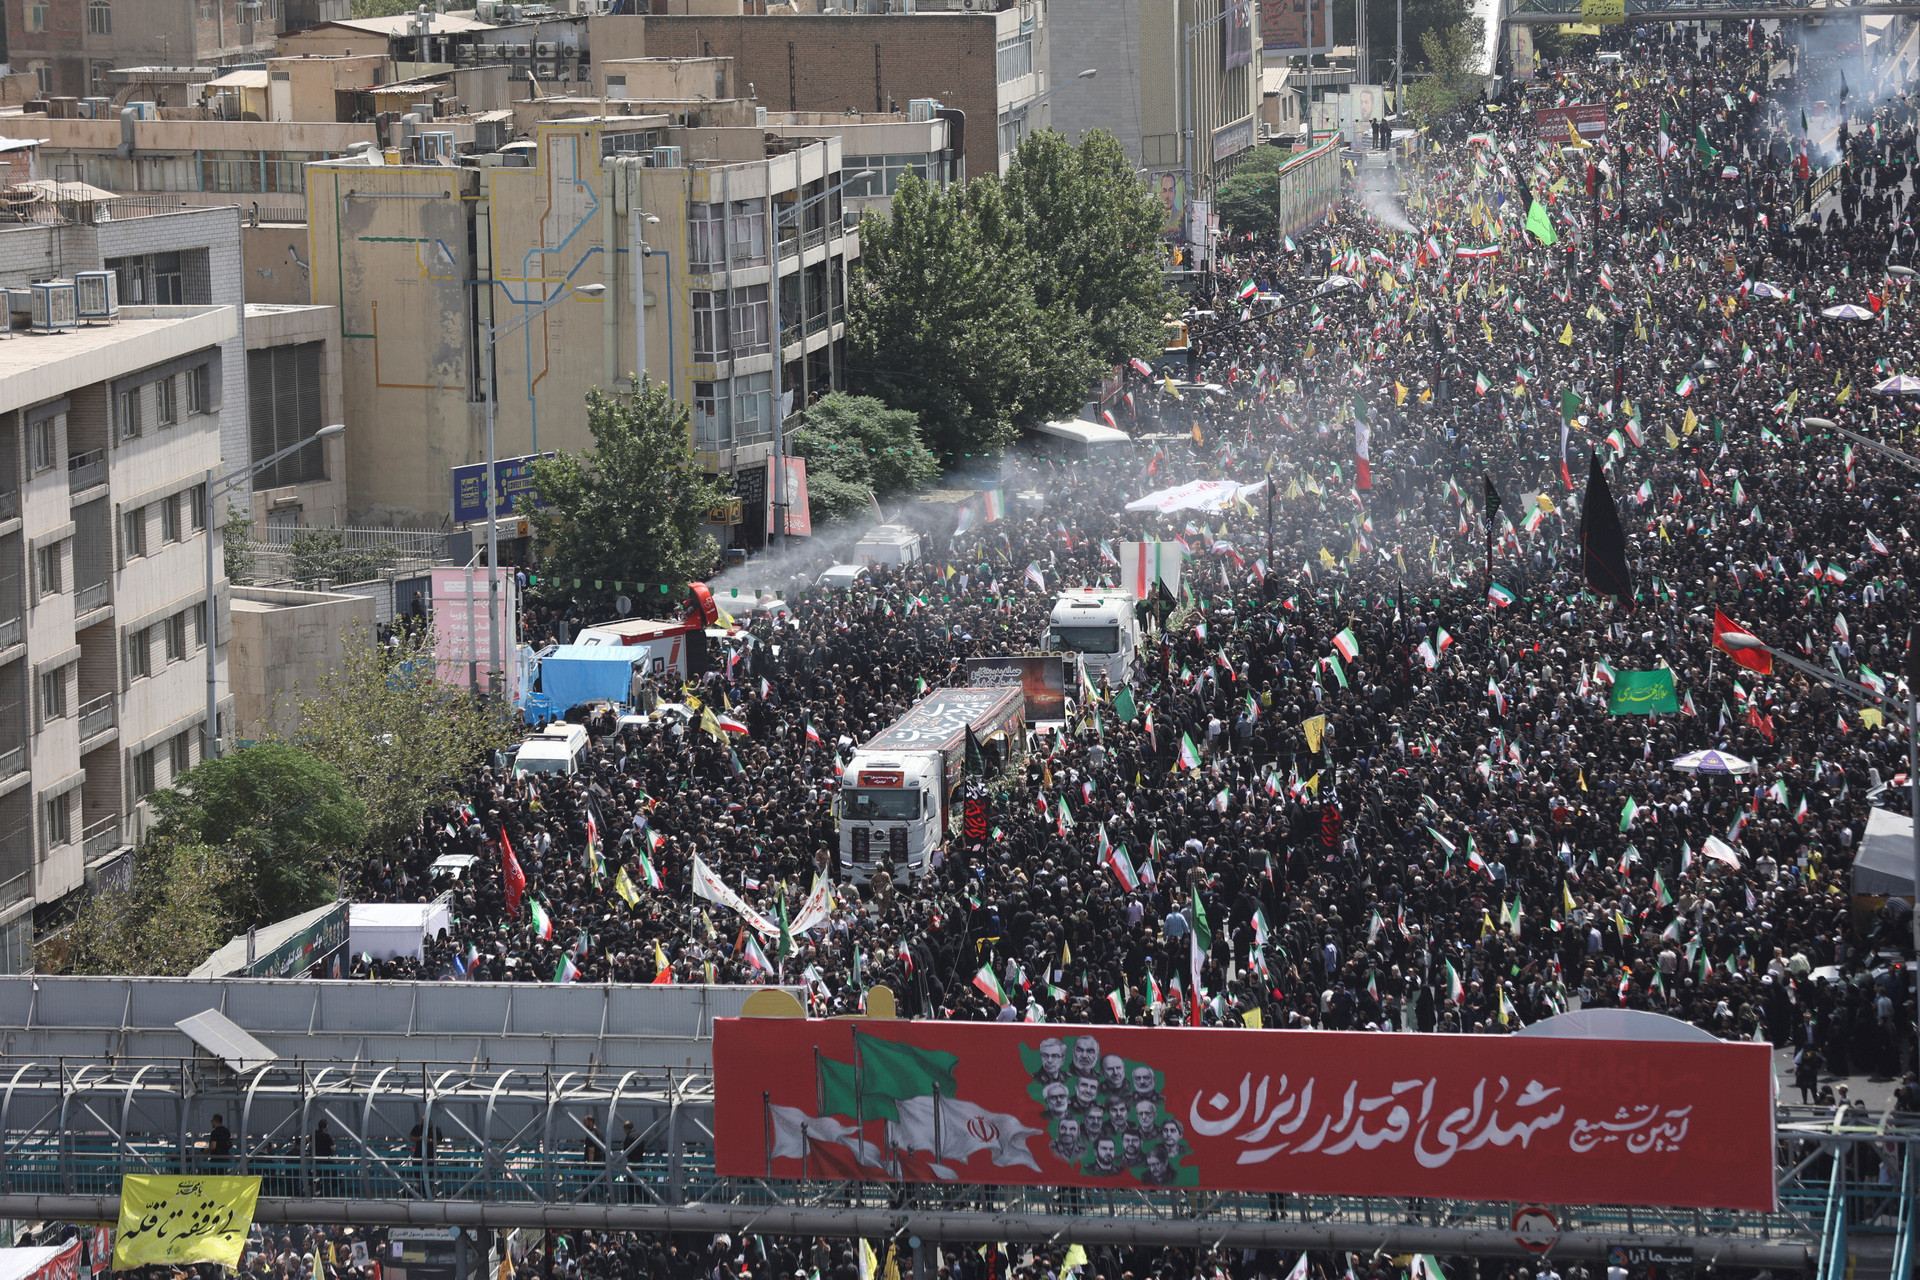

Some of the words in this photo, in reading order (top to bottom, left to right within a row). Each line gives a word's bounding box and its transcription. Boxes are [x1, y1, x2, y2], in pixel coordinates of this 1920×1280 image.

[1002, 666, 1022, 676] حمله
[1189, 1070, 1316, 1166] ایران
[1289, 1077, 1436, 1156] اقتدار
[1414, 1075, 1566, 1169] شهدای
[1568, 1103, 1660, 1154] تشییع
[1628, 1105, 1694, 1154] آیین
[157, 1209, 184, 1238] تا
[217, 1209, 241, 1241] بی
[1628, 1248, 1647, 1264] آرا
[1648, 1248, 1693, 1264] سیما
